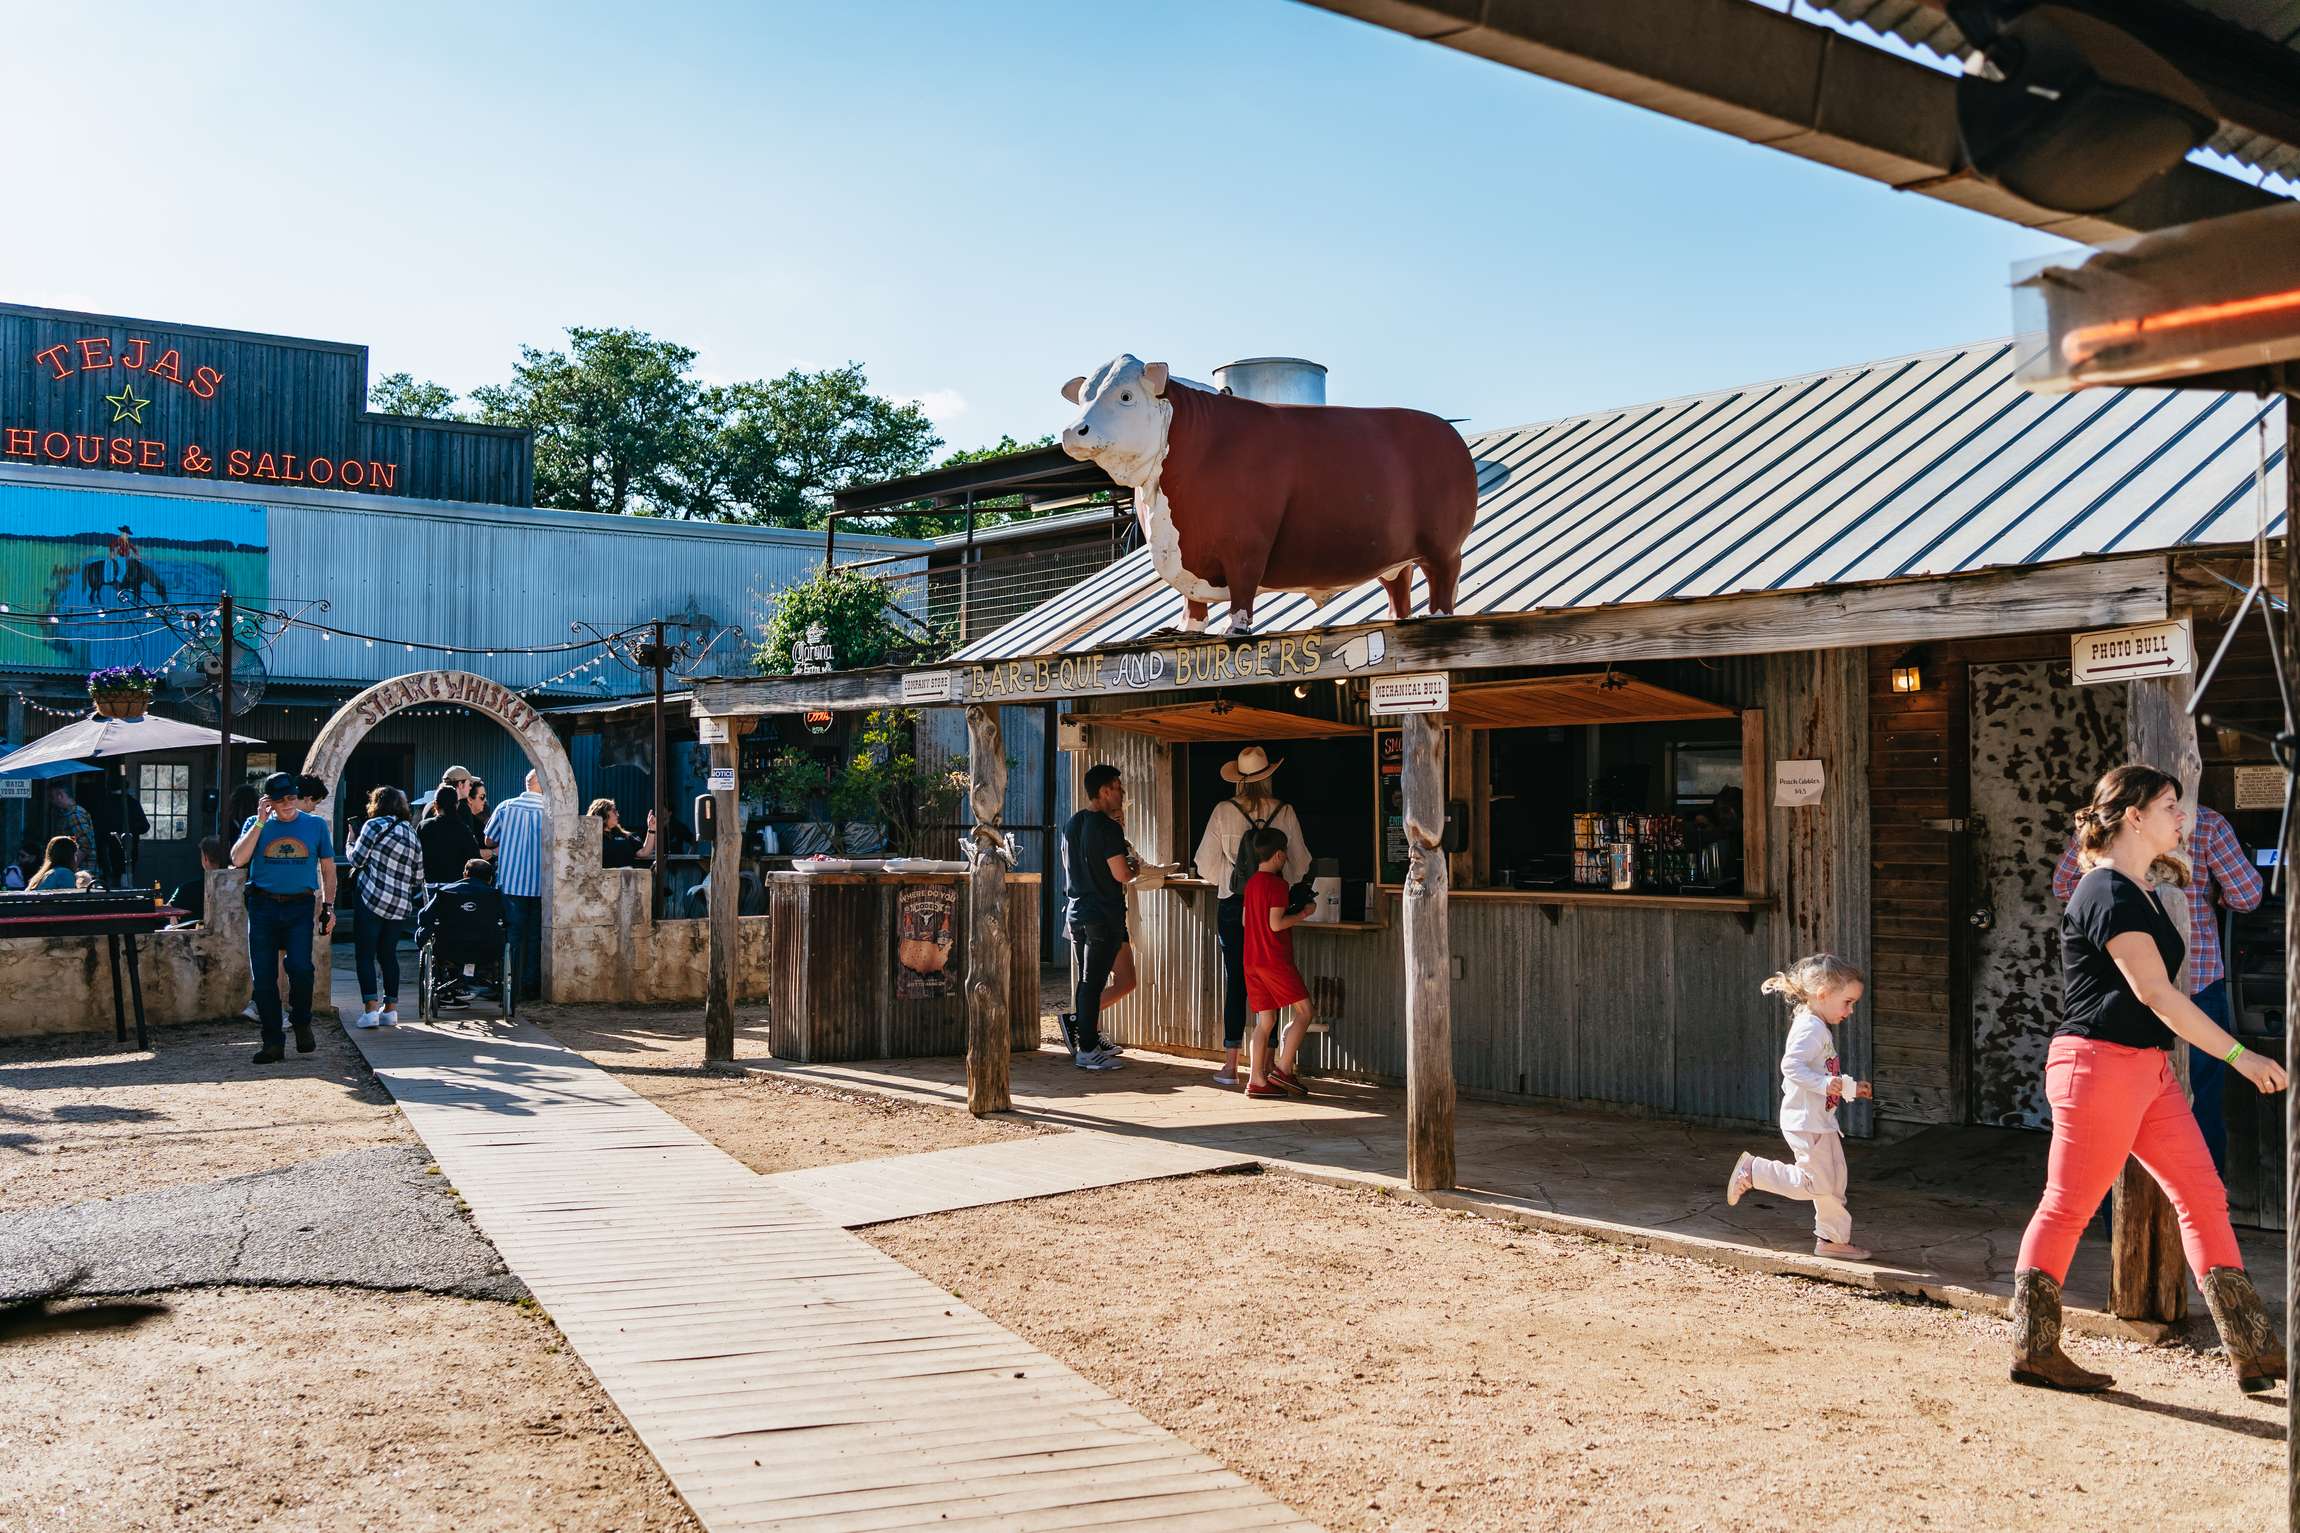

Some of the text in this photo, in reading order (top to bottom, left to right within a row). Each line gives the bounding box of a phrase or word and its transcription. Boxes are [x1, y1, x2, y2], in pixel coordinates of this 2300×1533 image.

[35, 337, 225, 398] TEJAS
[5, 427, 398, 489] HOUSE & SALOON
[792, 641, 834, 664] Corona
[2092, 635, 2168, 660] PHOTO BULL
[971, 634, 1323, 698] BAR-B-QUE AND BURGERS
[904, 677, 948, 690] COMPANY STORE
[1375, 681, 1442, 698] MECHANICAL BULL
[356, 675, 428, 726] STEAK
[445, 674, 540, 732] WHISKEY
[899, 889, 956, 903] WHERE DO YOU
